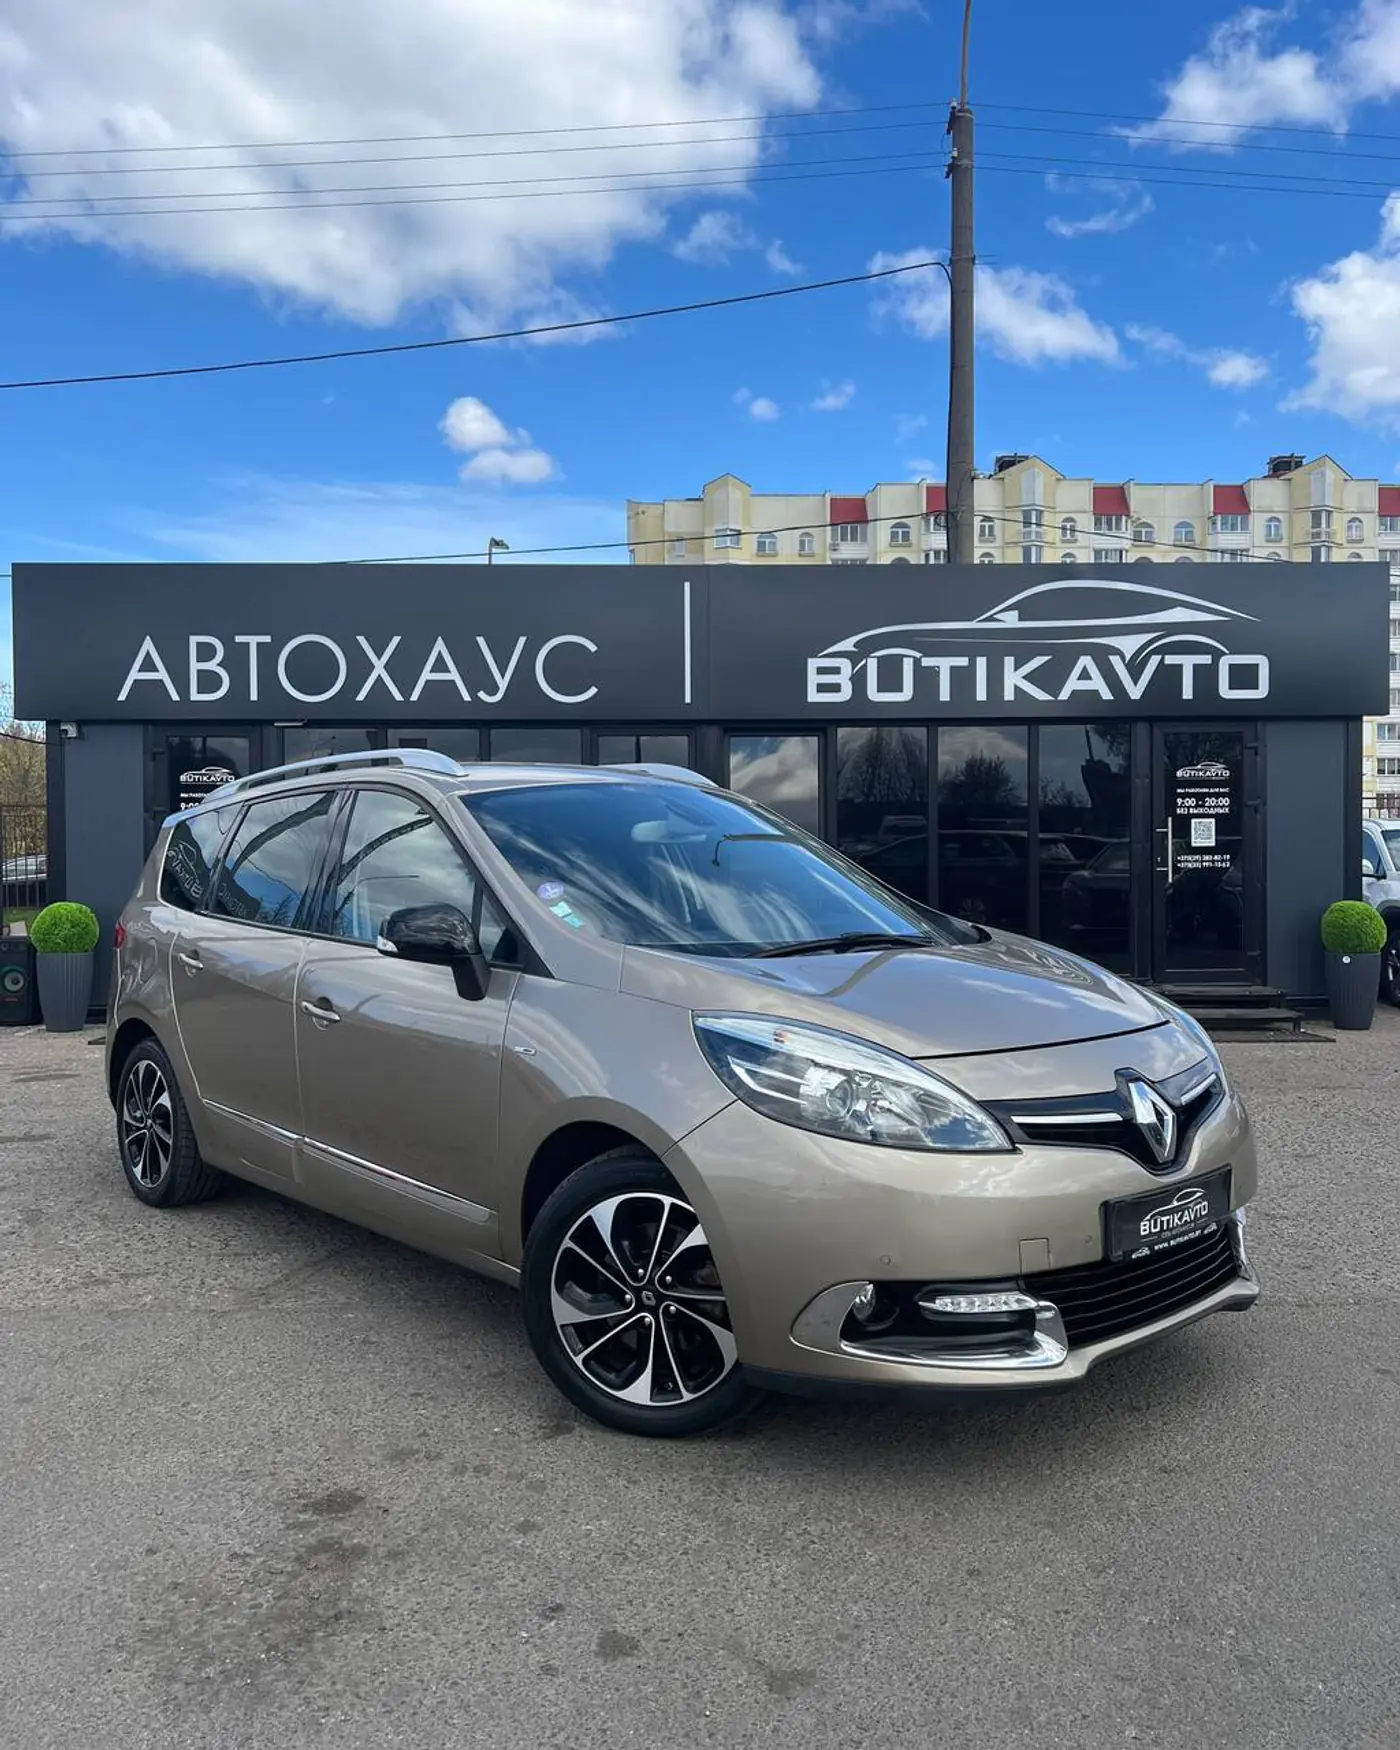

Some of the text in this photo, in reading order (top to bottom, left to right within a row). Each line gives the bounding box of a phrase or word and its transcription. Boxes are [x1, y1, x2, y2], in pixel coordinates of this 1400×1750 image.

[117, 633, 599, 704] АВТОХАУС
[806, 653, 1270, 703] BUTIKAVTO
[179, 774, 235, 782] BUTIKAVTO
[1176, 769, 1230, 778] BUTIKAVTO
[1176, 797, 1197, 807] 9:00
[1204, 797, 1230, 807] 20:00
[1176, 807, 1230, 815] БЕЗ ВЫХОДНЫХ
[1140, 1201, 1209, 1236] BUTIKAVTO
